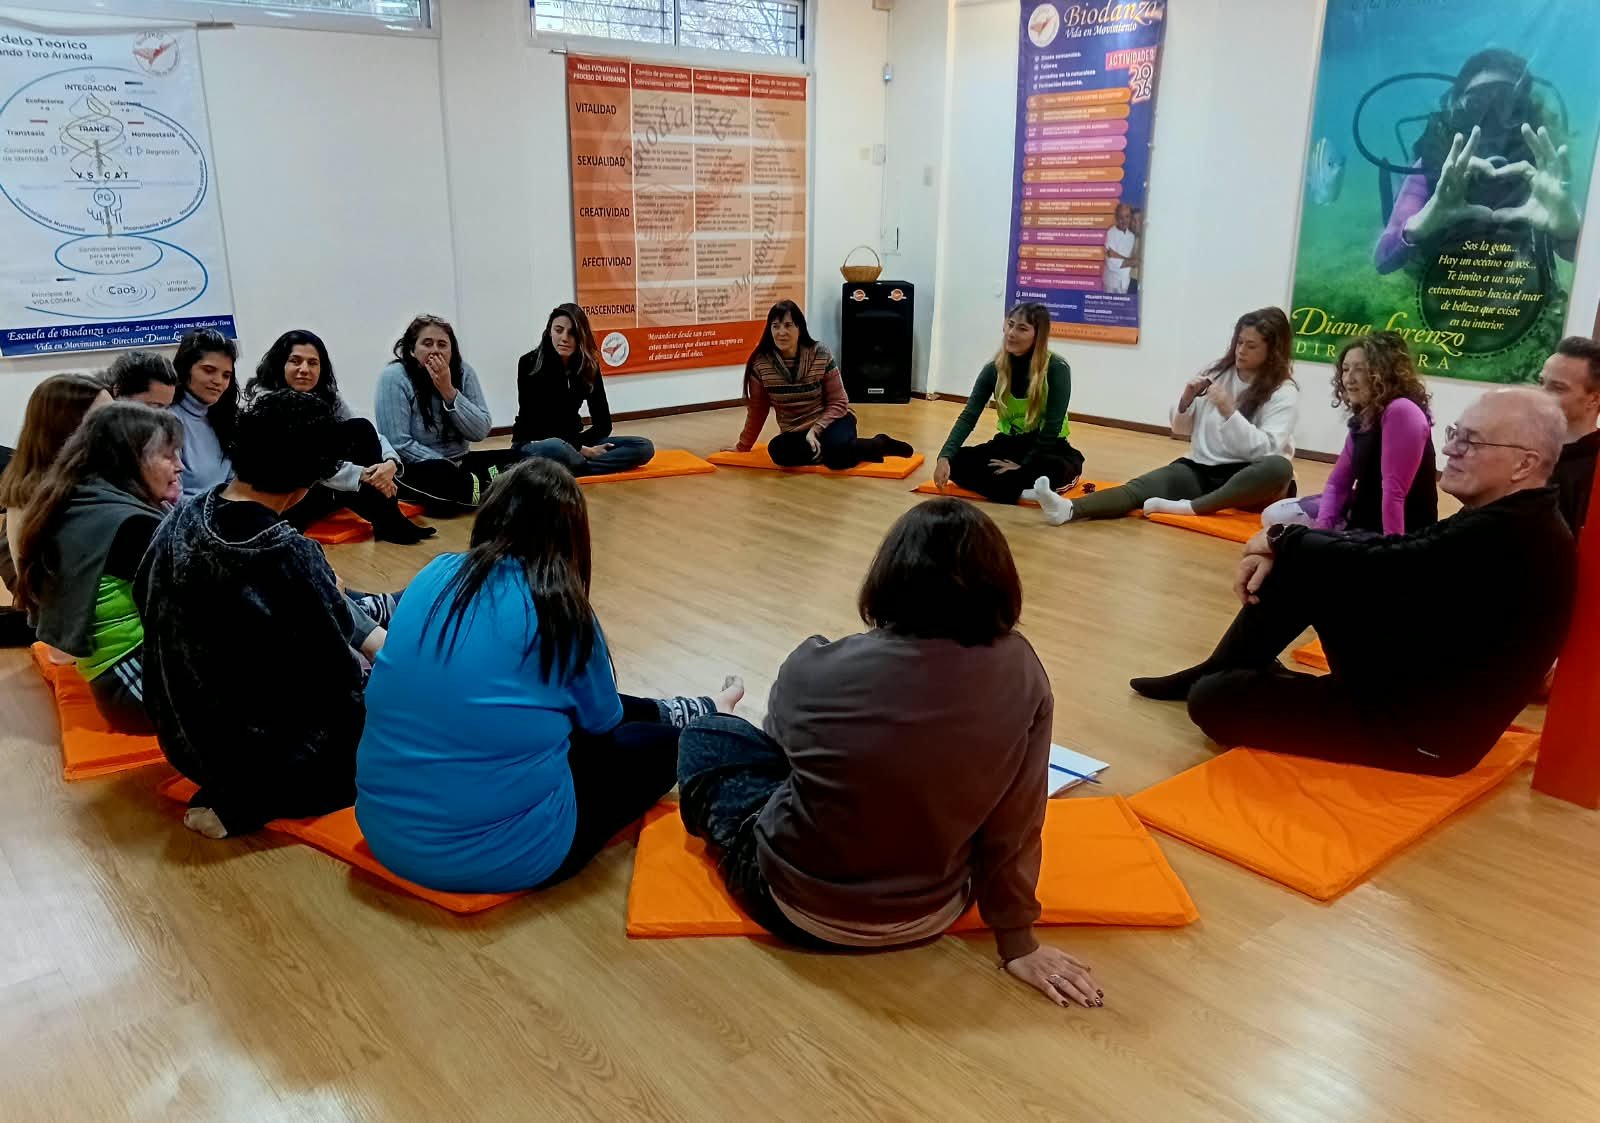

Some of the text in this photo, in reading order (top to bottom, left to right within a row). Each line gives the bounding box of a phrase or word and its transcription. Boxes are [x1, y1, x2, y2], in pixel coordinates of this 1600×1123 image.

[1064, 0, 1158, 26] Biodanza
[1066, 21, 1137, 38] Vida en Movimiento
[52, 50, 93, 61] Araneda
[1107, 48, 1155, 66] ACTIVIDADES
[64, 83, 117, 92] INTEGRACIÓN
[576, 102, 617, 115] VITALIDAD
[577, 155, 626, 167] SEXUALIDAD
[579, 206, 631, 218] CREATIVIDAD
[1462, 240, 1521, 256] Sos la gota...
[581, 255, 633, 268] AFECTIVIDAD
[1438, 254, 1459, 269] Hay
[1460, 257, 1471, 266] un
[1504, 259, 1514, 268] en
[1447, 270, 1457, 281] Te
[1457, 271, 1482, 282] invito
[1491, 276, 1504, 285] un
[1505, 274, 1526, 288] viaje
[108, 285, 137, 295] Caos
[1428, 285, 1544, 302] extraordinario hacia el mar
[1440, 300, 1521, 317] de belleza que existe
[1291, 307, 1373, 337] Diana
[1449, 318, 1505, 331] en tu interior.
[7, 328, 45, 341] Escuela
[47, 327, 59, 338] de
[60, 325, 104, 338] Biodanza
[34, 341, 53, 351] Vida
[54, 342, 63, 350] en
[111, 335, 144, 346] Directora
[144, 332, 171, 343] Diana
